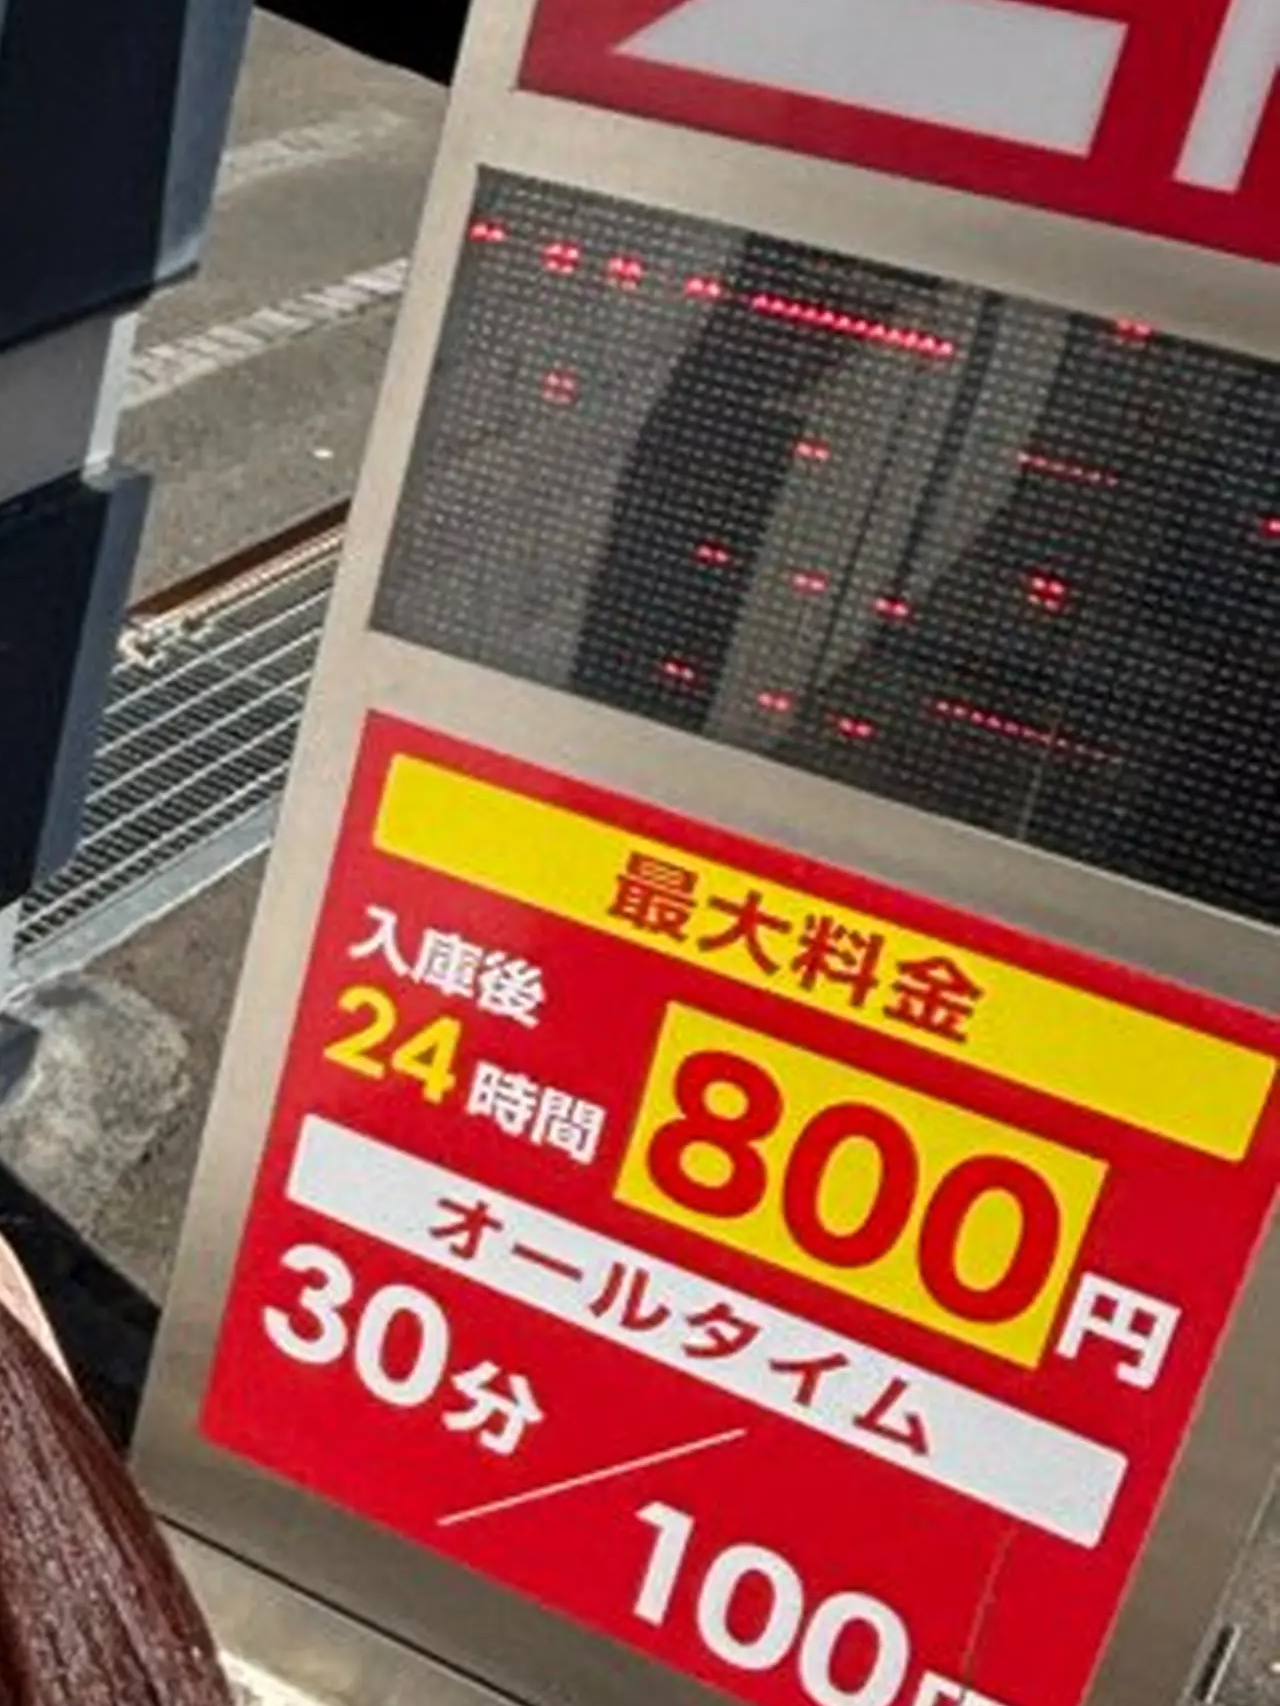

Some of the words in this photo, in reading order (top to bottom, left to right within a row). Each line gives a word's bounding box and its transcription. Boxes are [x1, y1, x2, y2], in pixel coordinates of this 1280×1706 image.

[349, 905, 545, 1028] 入庫後
[607, 851, 983, 1045] 最大料金
[263, 1243, 544, 1455] 30分
[428, 1194, 930, 1459] オールタイム
